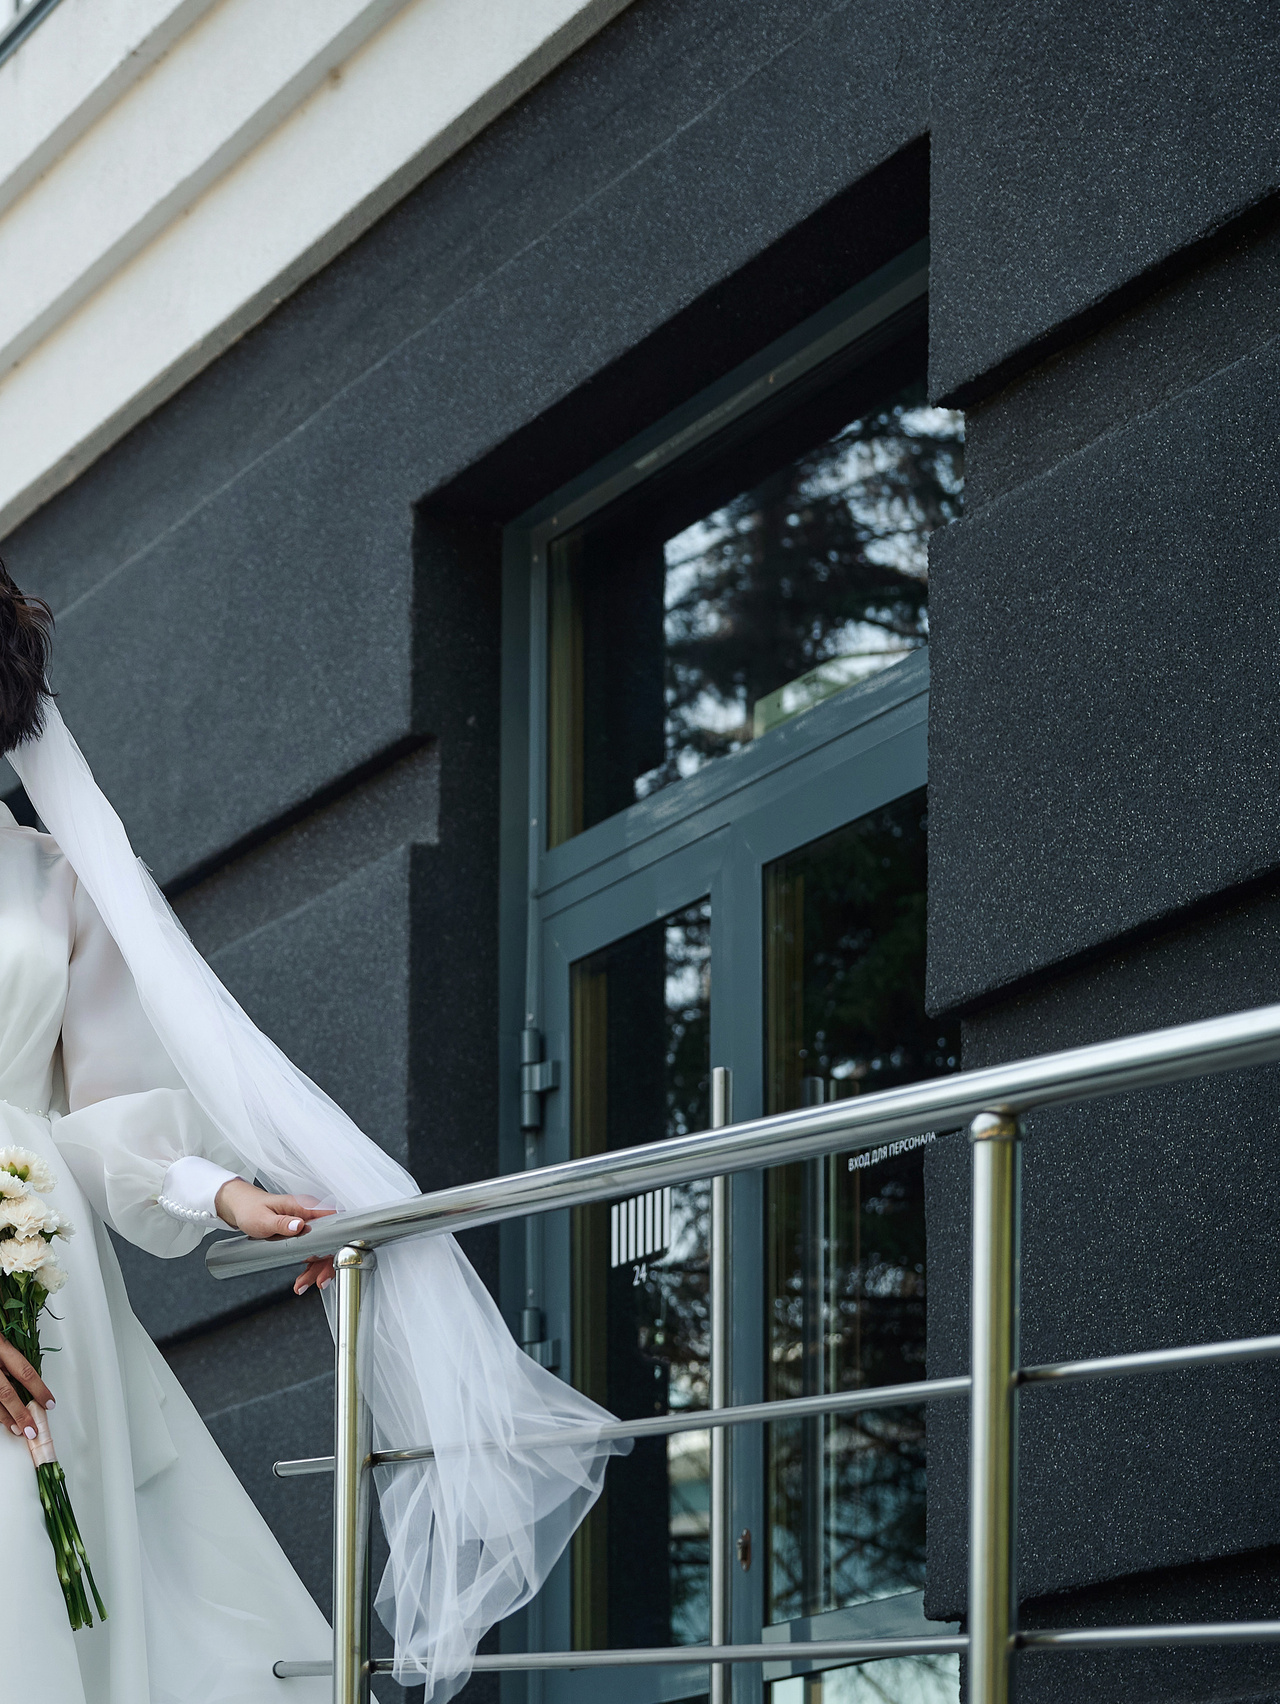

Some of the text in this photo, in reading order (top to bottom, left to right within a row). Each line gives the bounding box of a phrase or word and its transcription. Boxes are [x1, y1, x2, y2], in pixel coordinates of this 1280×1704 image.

[848, 1131, 936, 1172] ВХОД ДЛЯ ПЕРСОНАЛА
[632, 1262, 647, 1286] 24
